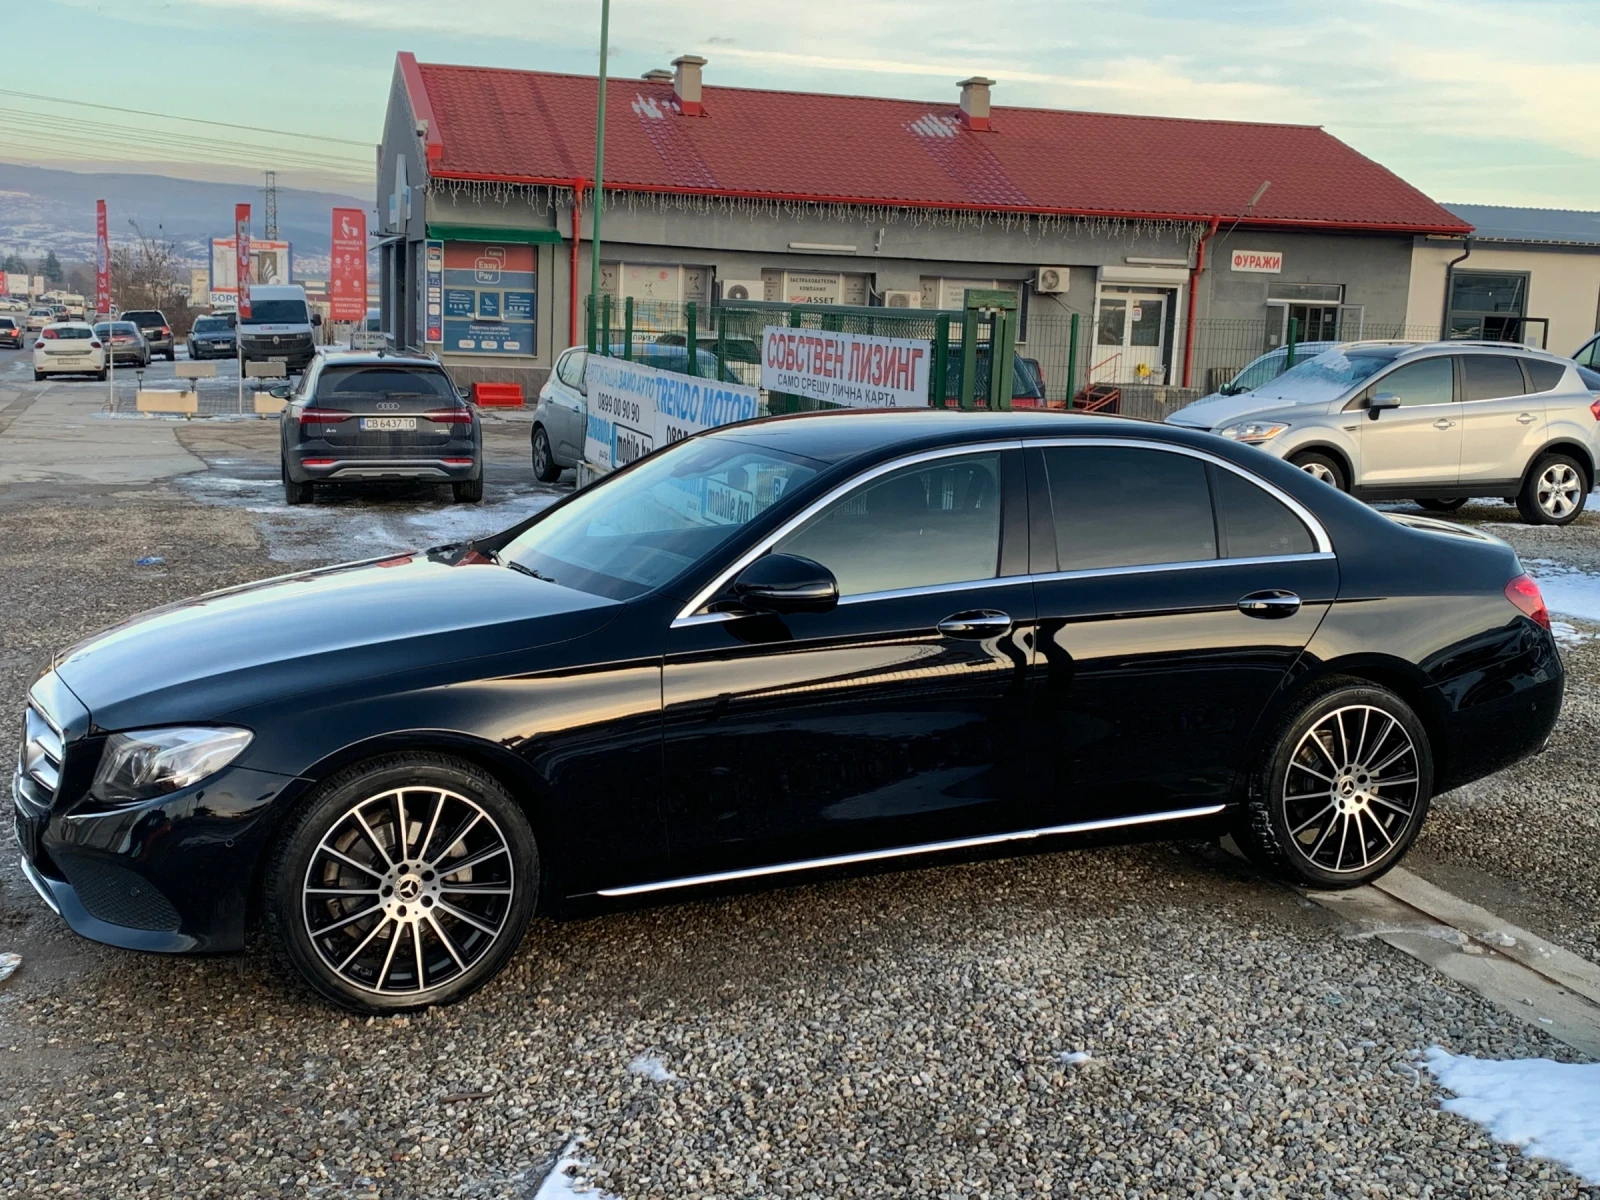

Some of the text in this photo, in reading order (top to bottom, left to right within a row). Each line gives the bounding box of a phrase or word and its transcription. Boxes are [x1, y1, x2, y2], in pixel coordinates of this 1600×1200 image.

[479, 261, 497, 270] Easy
[1234, 254, 1280, 269] ФУРАЖИ
[479, 272, 493, 280] Pay
[806, 296, 835, 304] ASSET
[767, 333, 924, 391] СОБСТВЕН ЛИЗИНГ
[777, 373, 896, 406] САМО СРЕЩУ ЛИЧНА КАРТА
[597, 392, 640, 423] 0899 00 90 90
[656, 377, 699, 423] TRENDO
[380, 419, 402, 428] 6437
